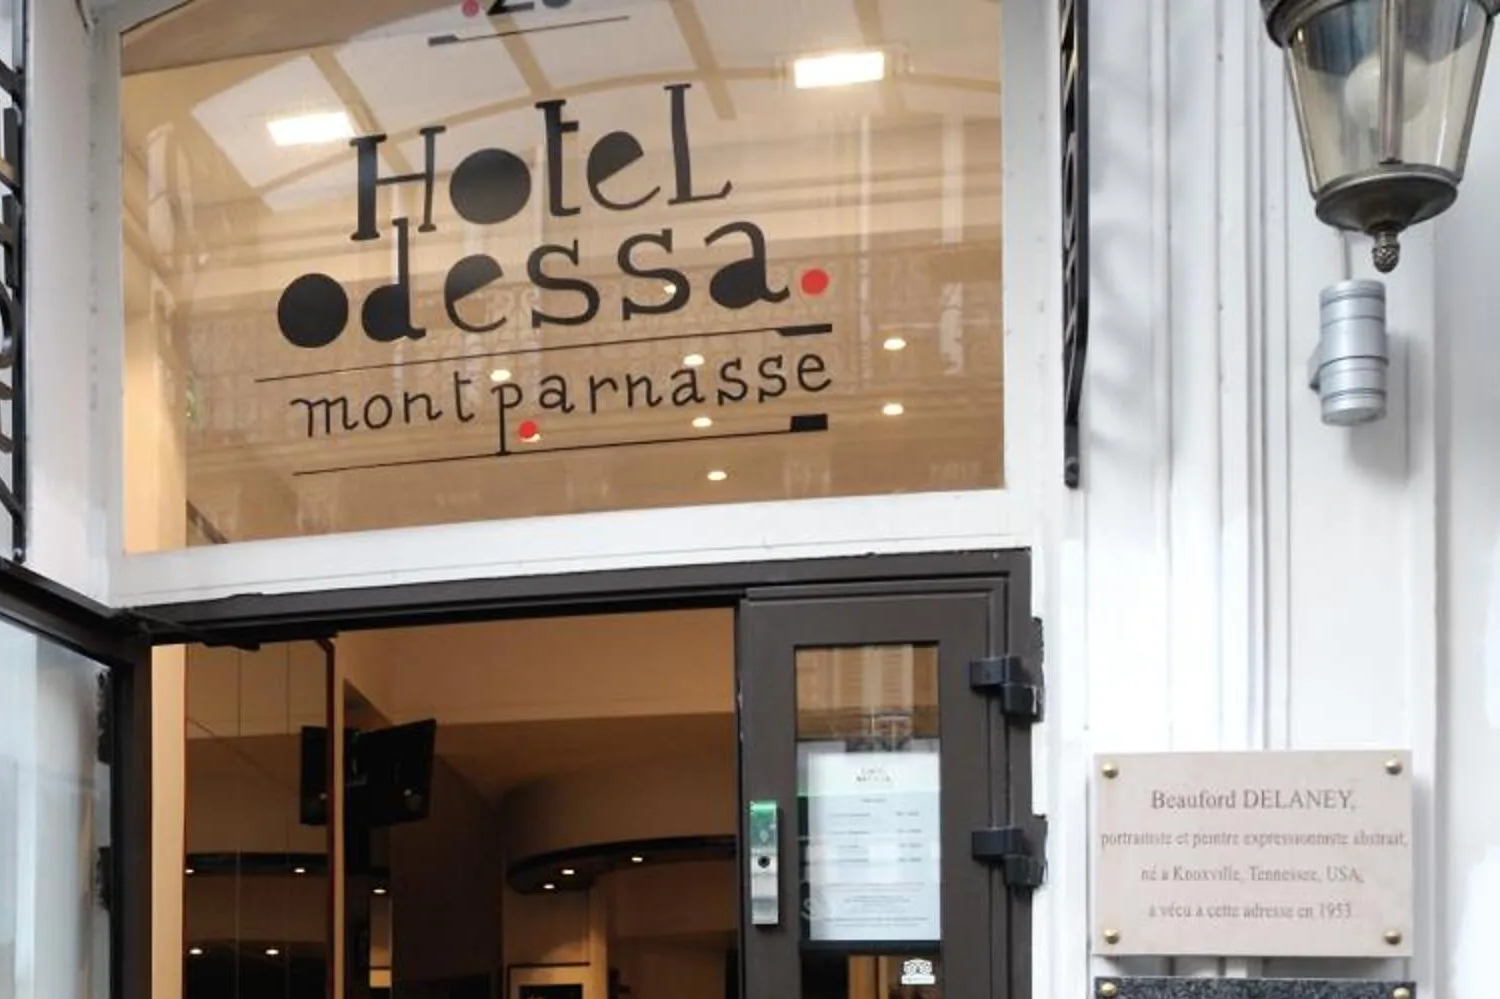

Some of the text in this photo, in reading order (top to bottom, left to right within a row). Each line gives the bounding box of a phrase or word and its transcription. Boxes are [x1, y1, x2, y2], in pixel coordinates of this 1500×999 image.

[291, 350, 832, 457] montparnasse
[1150, 789, 1356, 811] Beauford DELANEY,
[1175, 832, 1189, 845] et
[1192, 831, 1239, 848] peintre
[1141, 866, 1156, 881] né
[1160, 903, 1191, 918] vécu
[1207, 903, 1240, 918] cette
[1243, 901, 1293, 919] adresse
[1297, 906, 1313, 918] en
